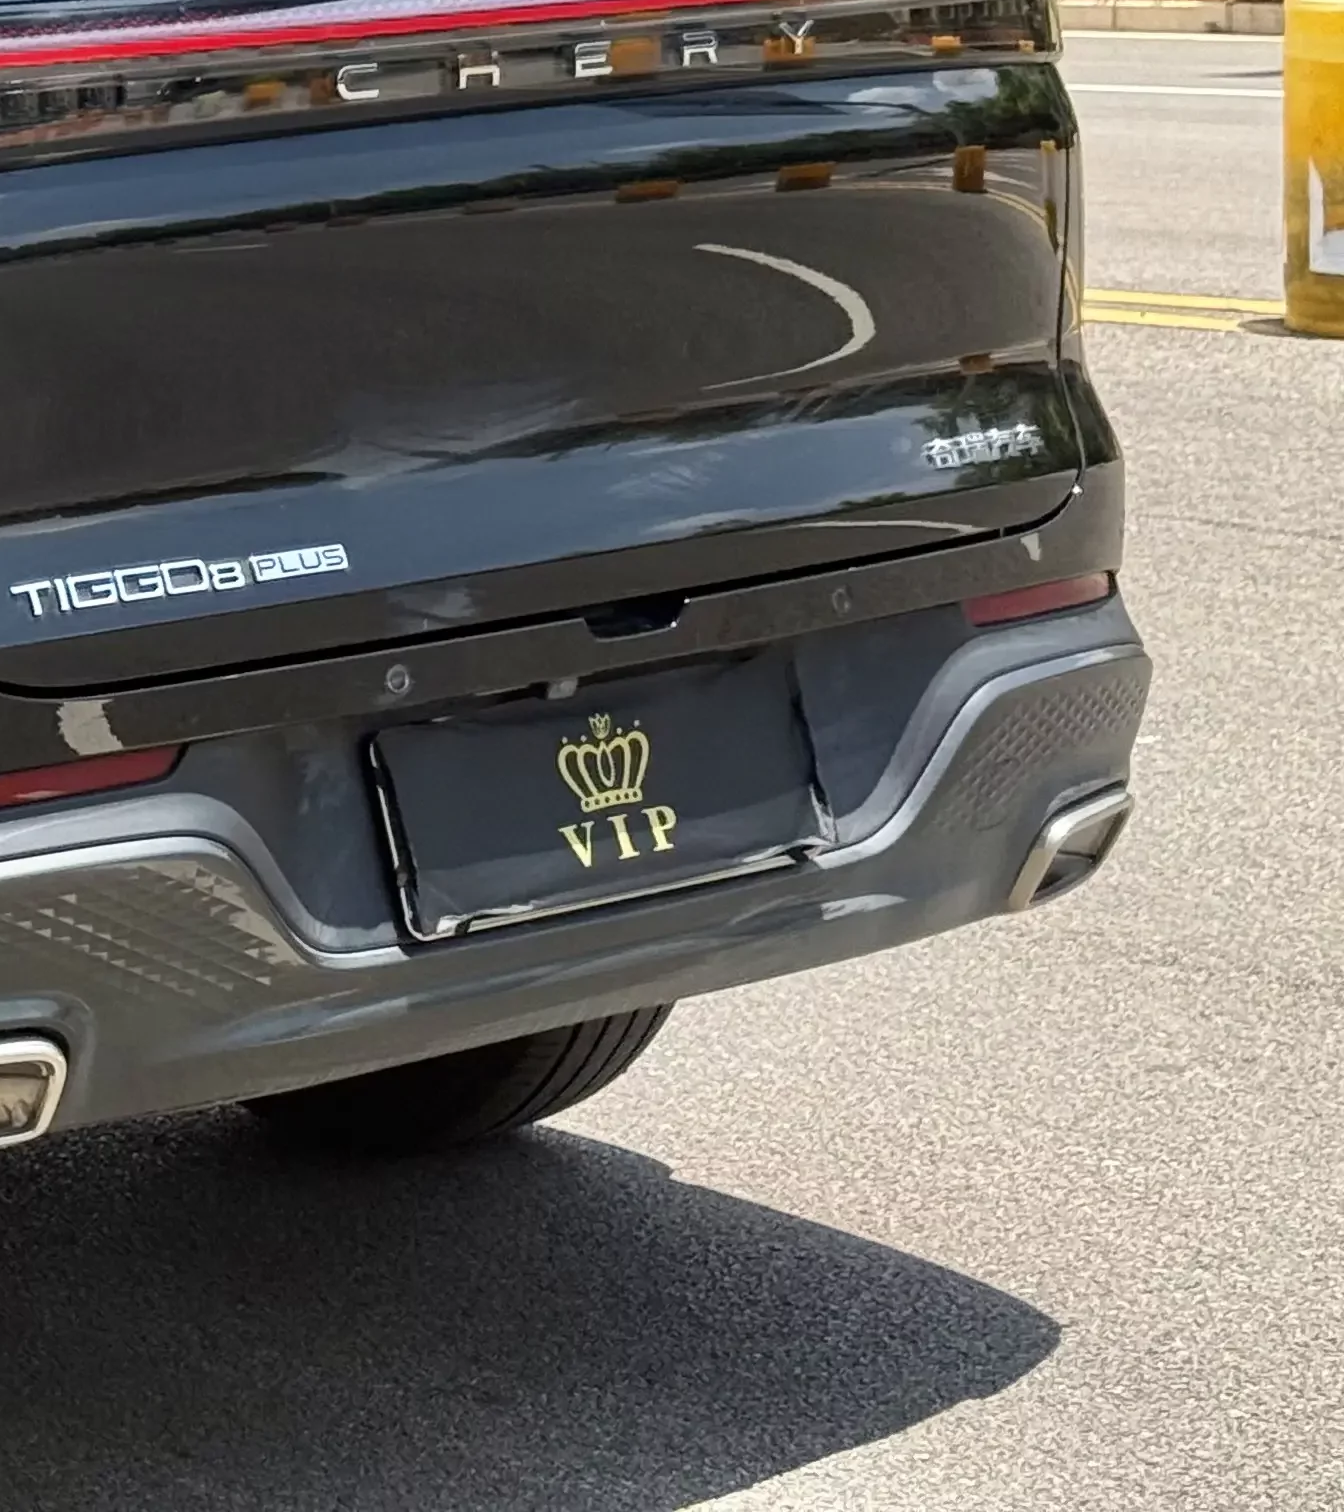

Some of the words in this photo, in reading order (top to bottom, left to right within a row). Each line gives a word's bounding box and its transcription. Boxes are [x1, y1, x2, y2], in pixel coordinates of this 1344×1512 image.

[335, 19, 816, 101] CHERY
[254, 546, 347, 579] PLUS
[557, 805, 678, 868] VIP
